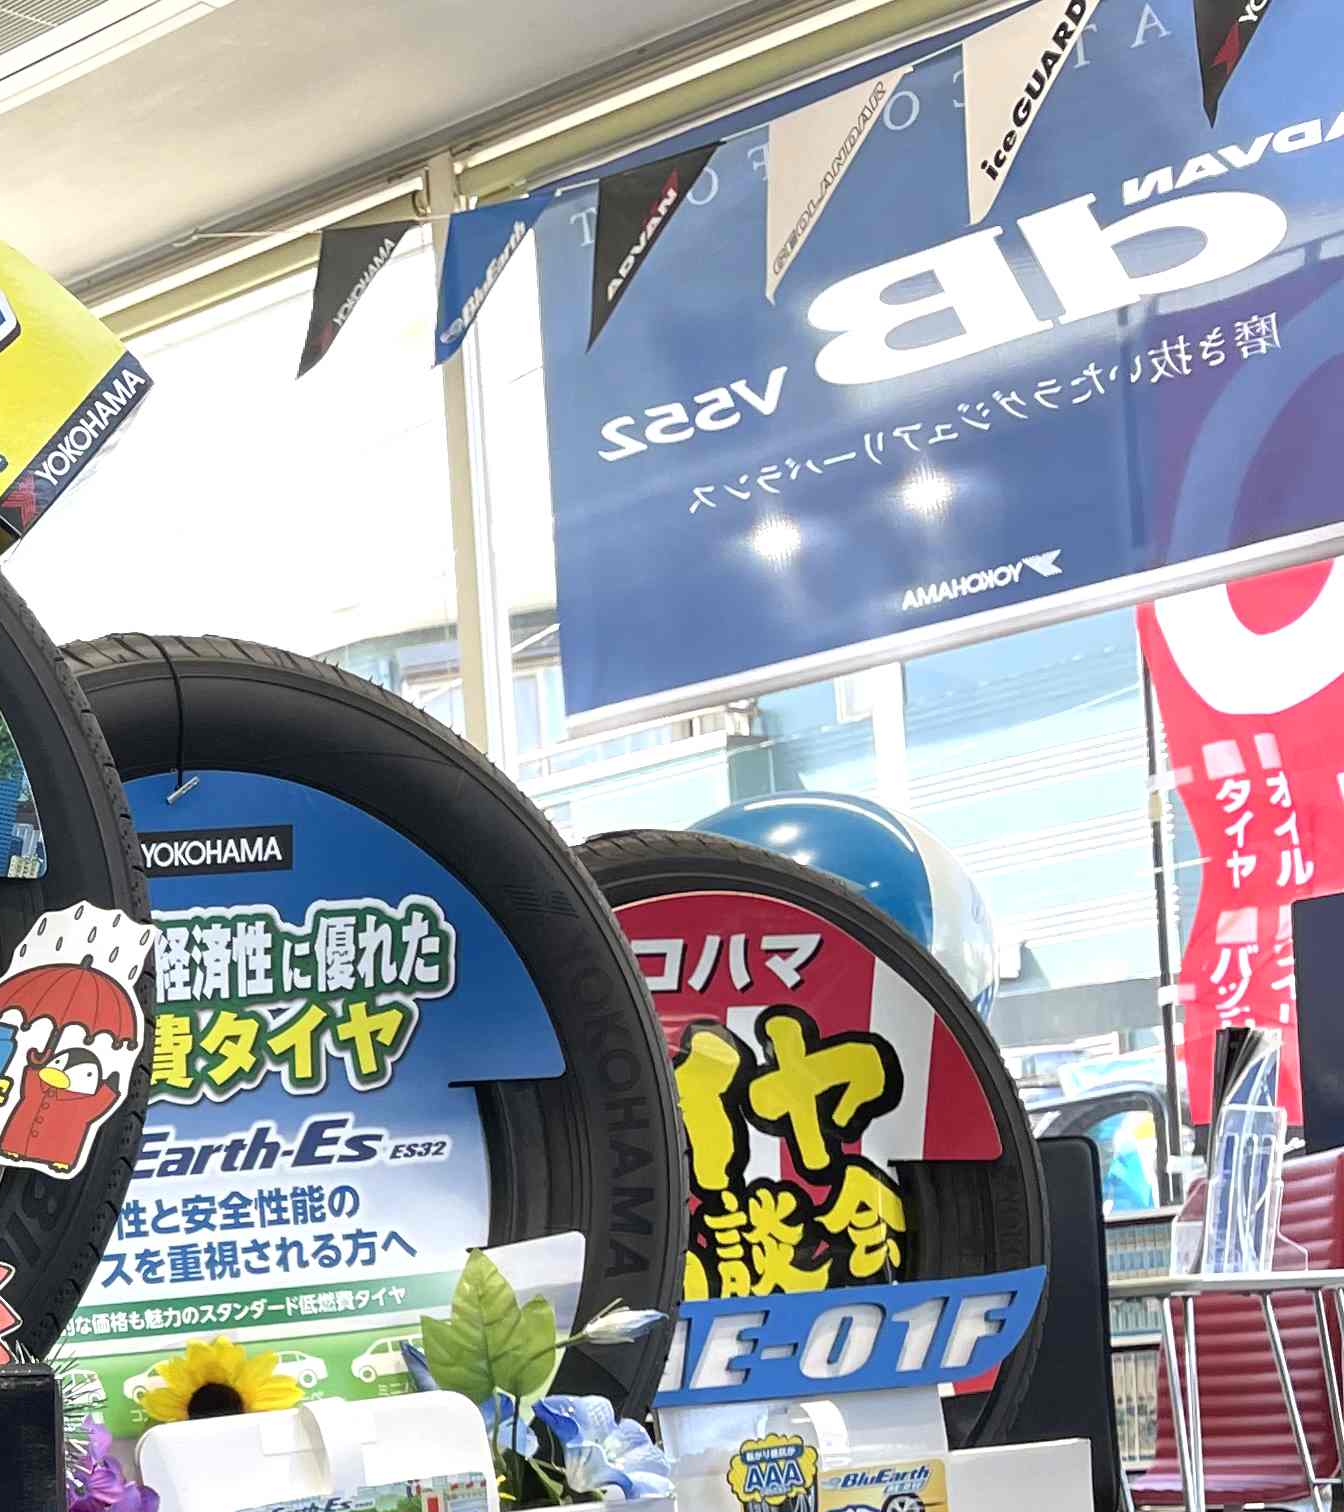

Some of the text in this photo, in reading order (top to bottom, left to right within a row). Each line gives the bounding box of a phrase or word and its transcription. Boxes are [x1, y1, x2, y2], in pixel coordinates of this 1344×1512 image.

[981, 0, 1089, 180] iceGUARD
[774, 81, 887, 277] GEOLANDAR
[333, 238, 395, 325] YOKOHAMA
[461, 222, 526, 327] BluEarth
[608, 187, 678, 299] ADVAN
[34, 367, 146, 487] YOKOHAMA
[140, 835, 283, 868] YOKOHAMA
[1216, 778, 1258, 889] タイヤ
[1267, 772, 1313, 888] オイル
[154, 908, 444, 1003] 経済性に優れた
[388, 1139, 448, 1162] ES32
[101, 1229, 418, 1290] スを重視される方へ
[115, 1183, 360, 1242] 性と安全性能の
[745, 1459, 804, 1493] AAA
[840, 1465, 930, 1489] BluEarth
